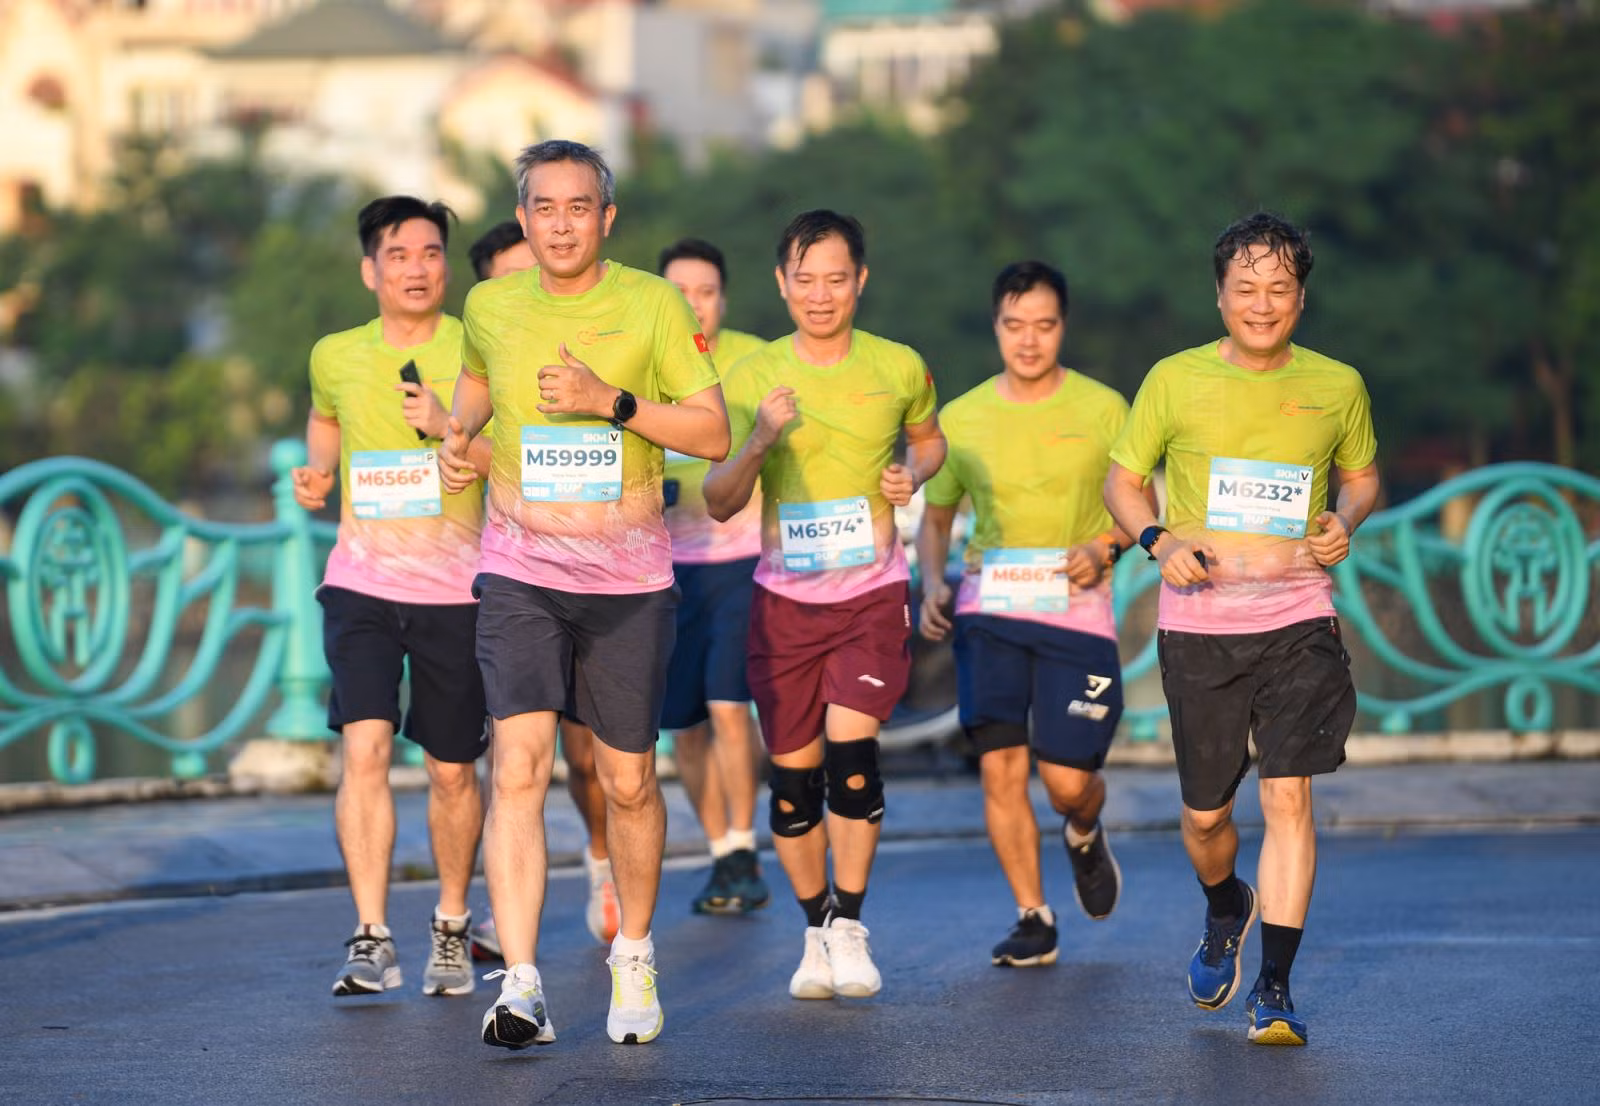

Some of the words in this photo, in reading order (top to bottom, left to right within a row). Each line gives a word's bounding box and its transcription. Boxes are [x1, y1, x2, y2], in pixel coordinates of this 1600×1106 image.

[582, 433, 607, 443] 5KM
[610, 433, 618, 441] V
[526, 449, 617, 466] M59999
[1275, 469, 1298, 479] 5KM
[1301, 472, 1309, 480] V
[858, 501, 865, 509] V
